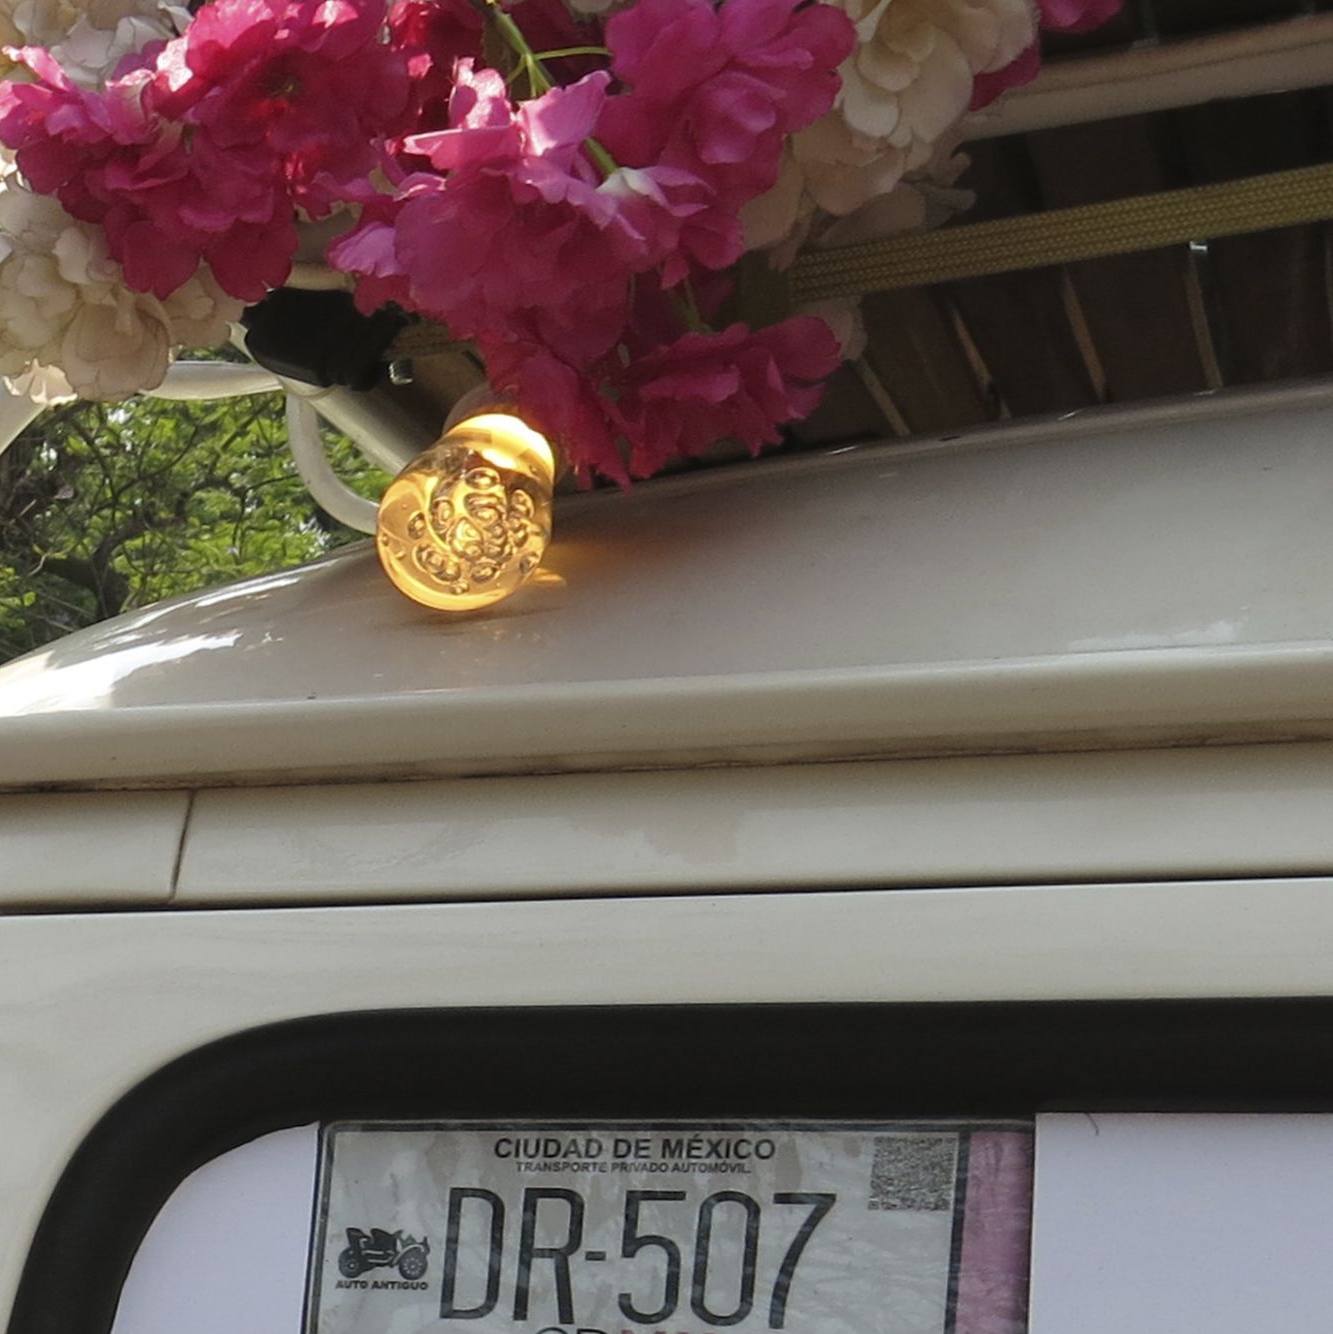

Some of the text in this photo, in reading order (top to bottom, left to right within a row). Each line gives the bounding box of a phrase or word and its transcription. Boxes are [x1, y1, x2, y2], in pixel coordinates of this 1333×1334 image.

[494, 1133, 776, 1161] CIUDAD DE MÉXICO
[516, 1161, 607, 1173] TRANSPORTE
[611, 1162, 668, 1174] PRIVADO
[439, 1187, 836, 1329] DR-507
[336, 1280, 429, 1290] AUTO ANTIGUO
